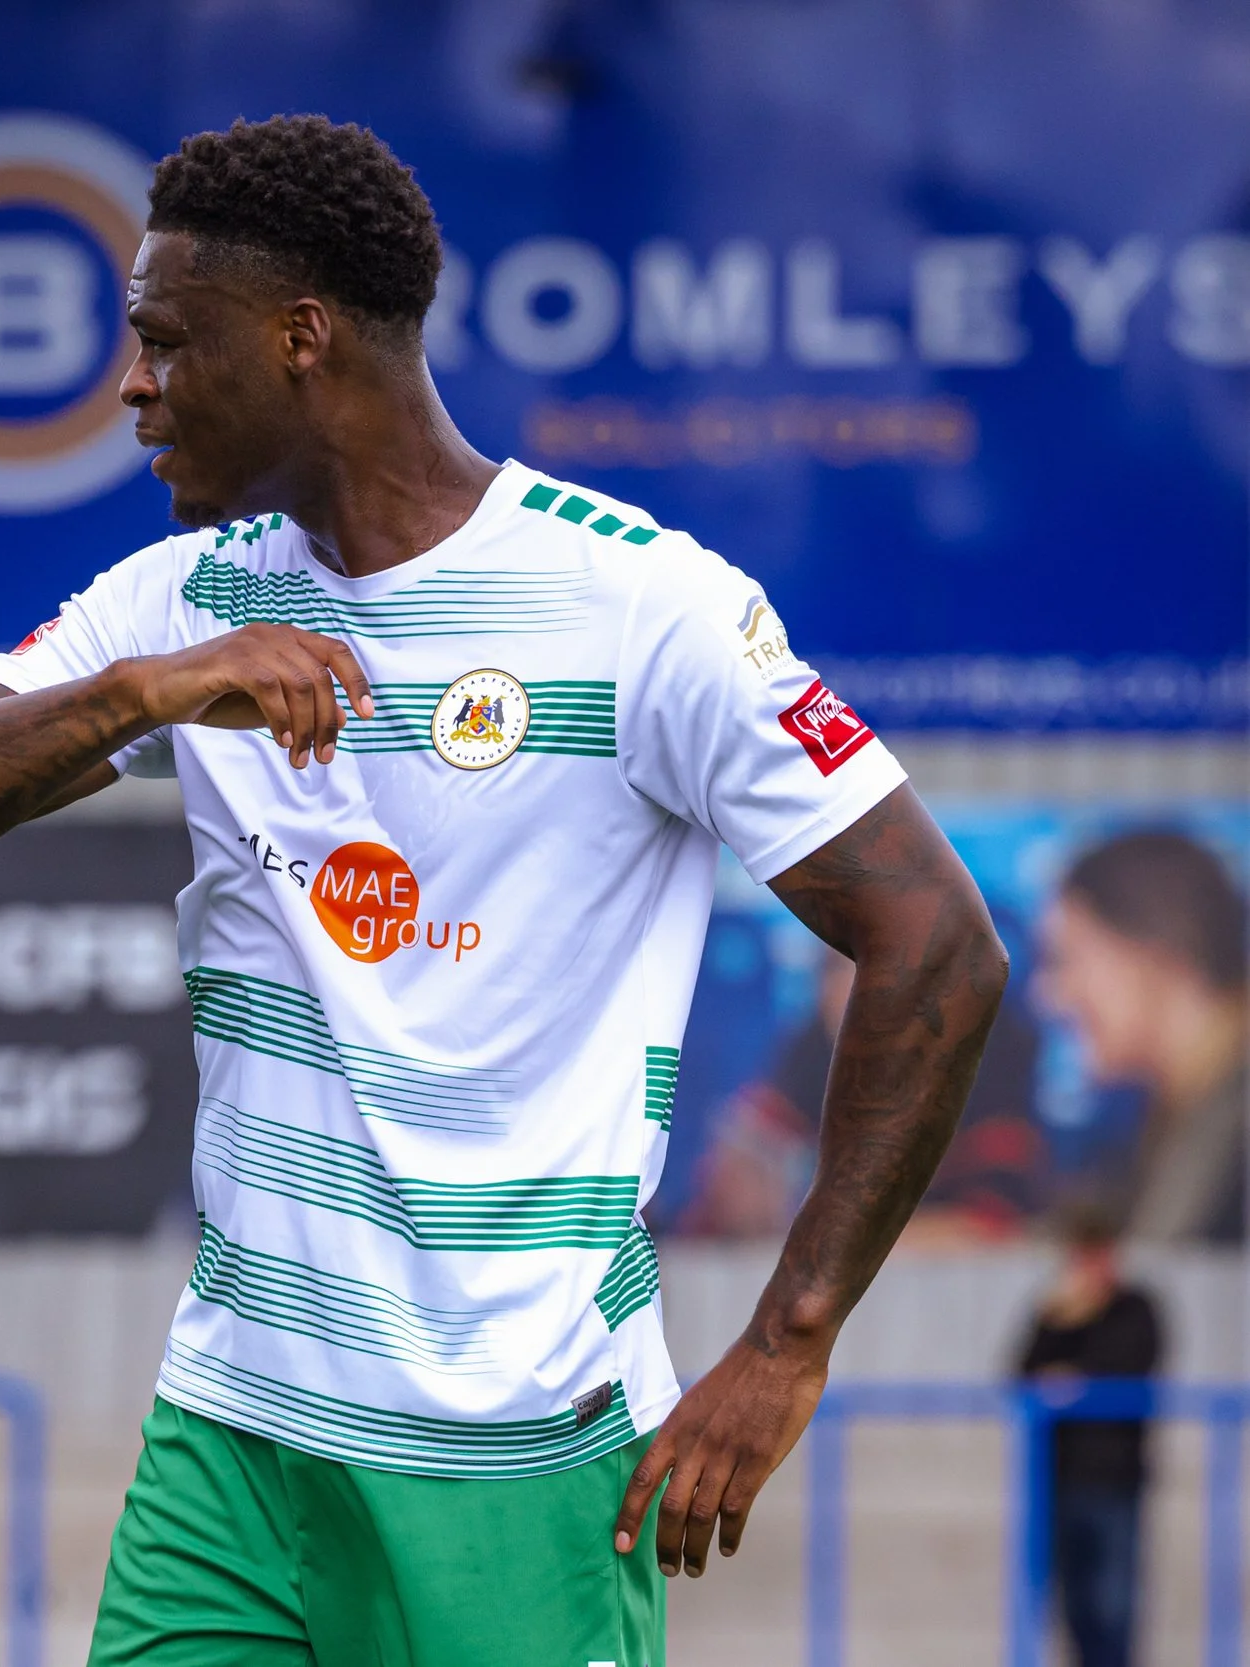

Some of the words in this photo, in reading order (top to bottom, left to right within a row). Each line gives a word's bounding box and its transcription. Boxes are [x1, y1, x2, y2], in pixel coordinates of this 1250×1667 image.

[430, 234, 1250, 374] OMLEYS
[320, 864, 411, 908] MAE
[349, 913, 482, 962] group
